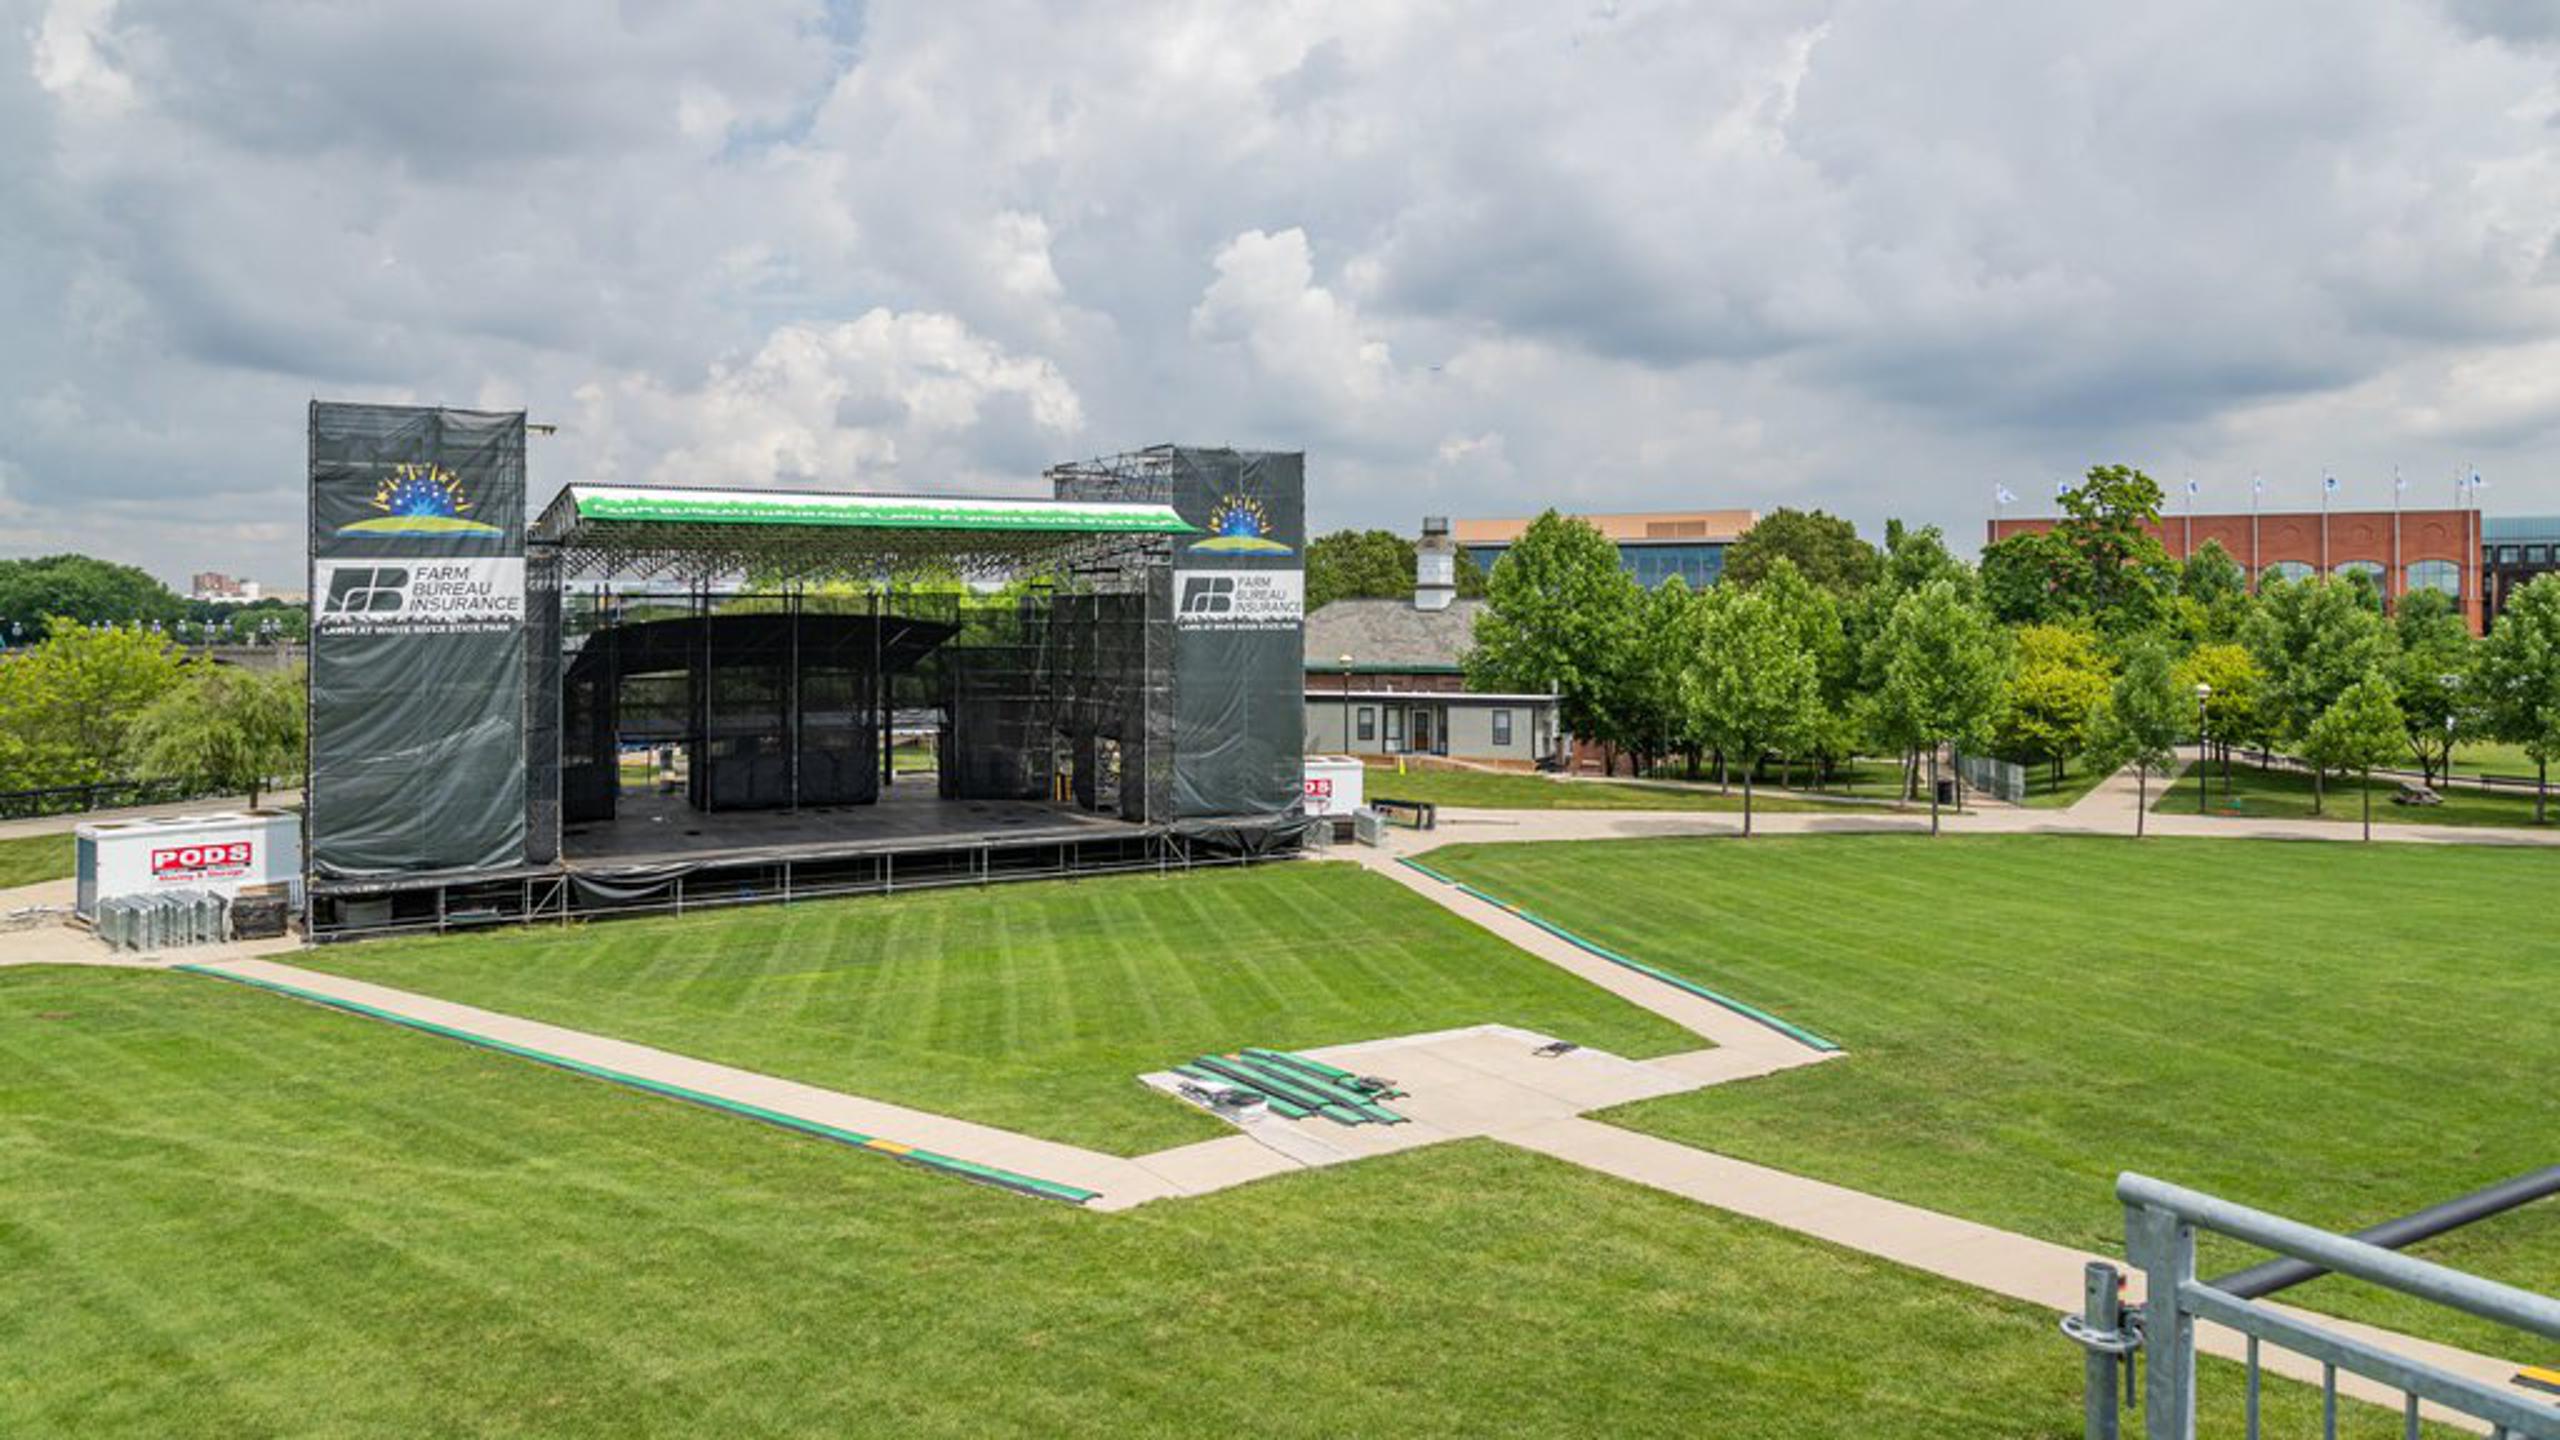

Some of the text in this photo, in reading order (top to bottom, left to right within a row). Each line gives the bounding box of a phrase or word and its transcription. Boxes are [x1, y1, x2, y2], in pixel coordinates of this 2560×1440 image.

[414, 567, 471, 581] FARM
[412, 581, 493, 596] BUREAU
[1237, 576, 1272, 588] FARM
[1236, 588, 1287, 600] BUREAU
[409, 596, 520, 612] INSURANCE
[1235, 600, 1301, 614] INSURANCE
[322, 622, 511, 635] LAWN AT WHITE RIVER STATE PARK
[154, 844, 248, 868] PODS
[159, 873, 193, 881] Moving
[207, 869, 244, 877] Storage
